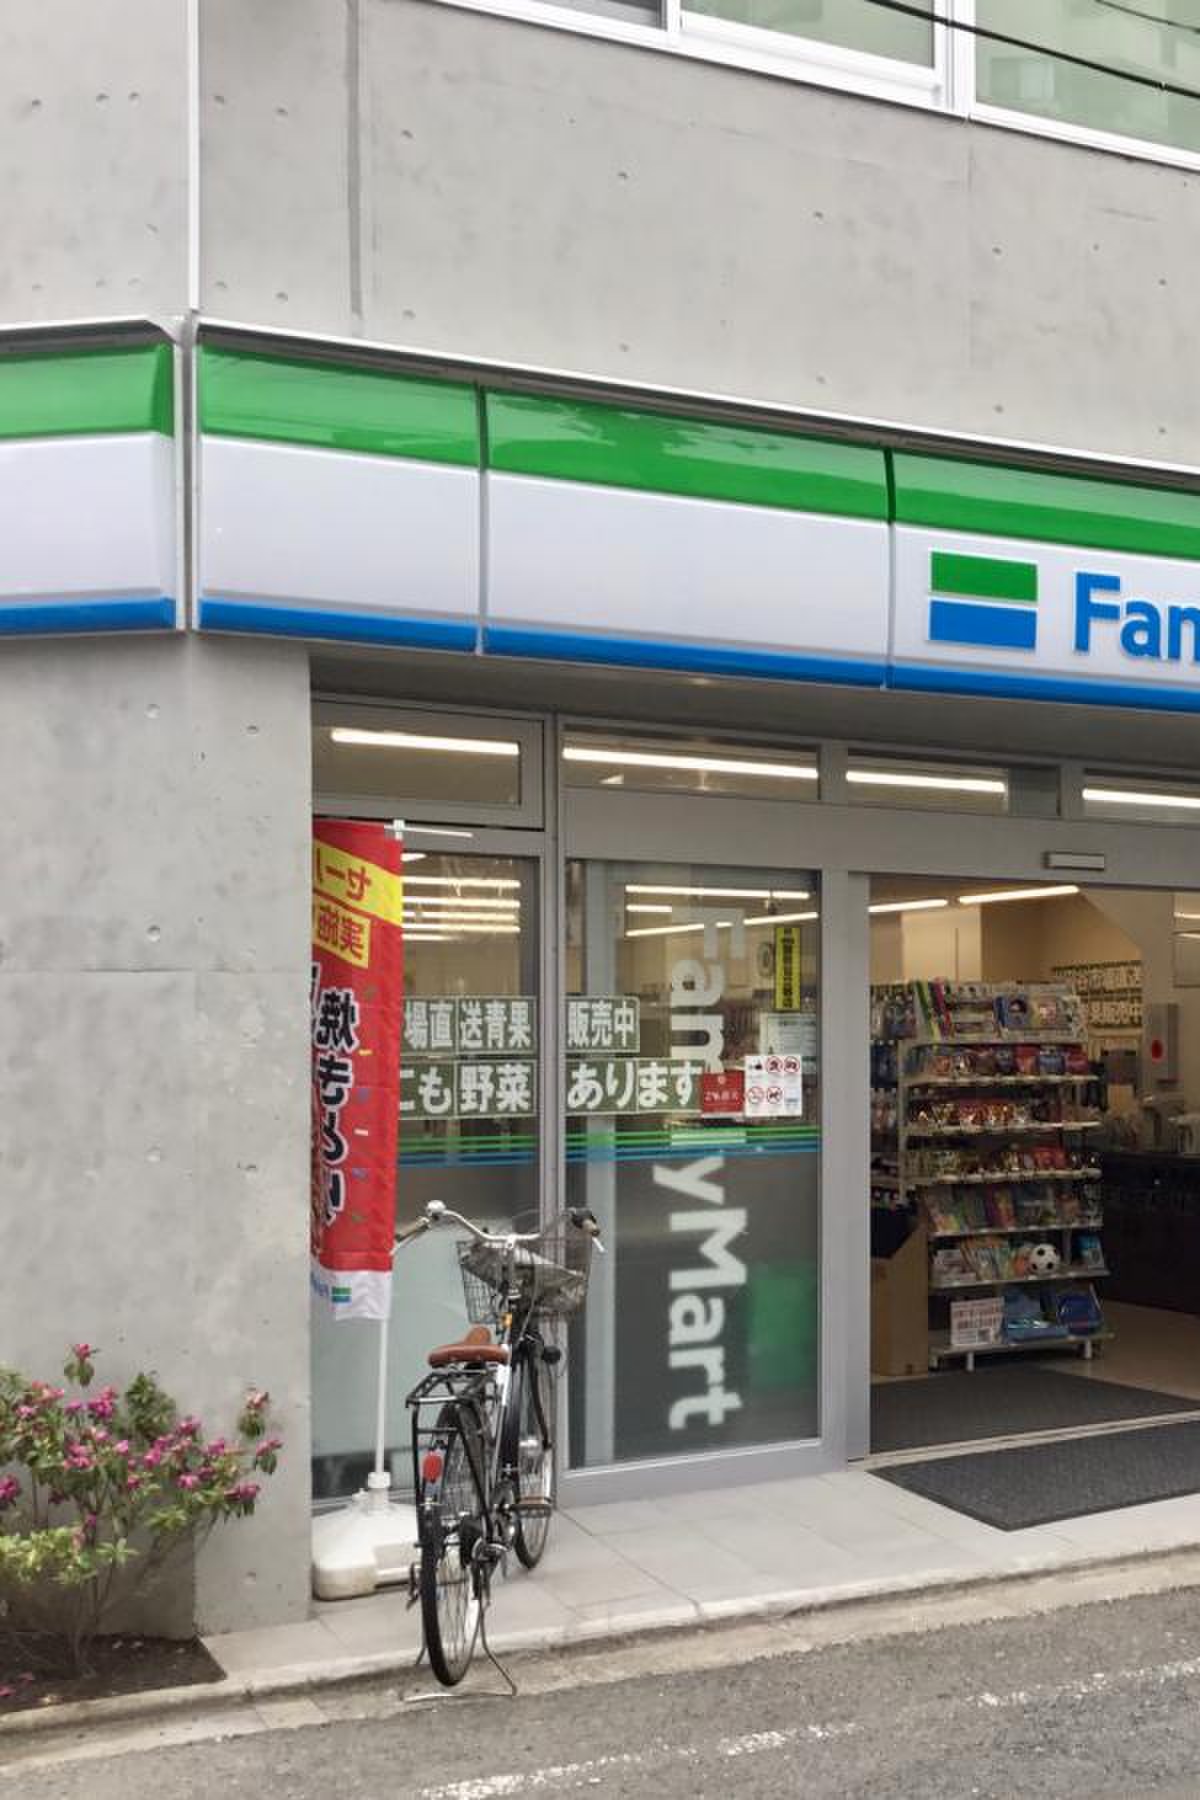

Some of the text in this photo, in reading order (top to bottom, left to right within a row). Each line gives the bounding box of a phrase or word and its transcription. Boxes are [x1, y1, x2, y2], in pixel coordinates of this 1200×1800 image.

[567, 1000, 636, 1048] 販売中
[567, 1062, 703, 1108] あります
